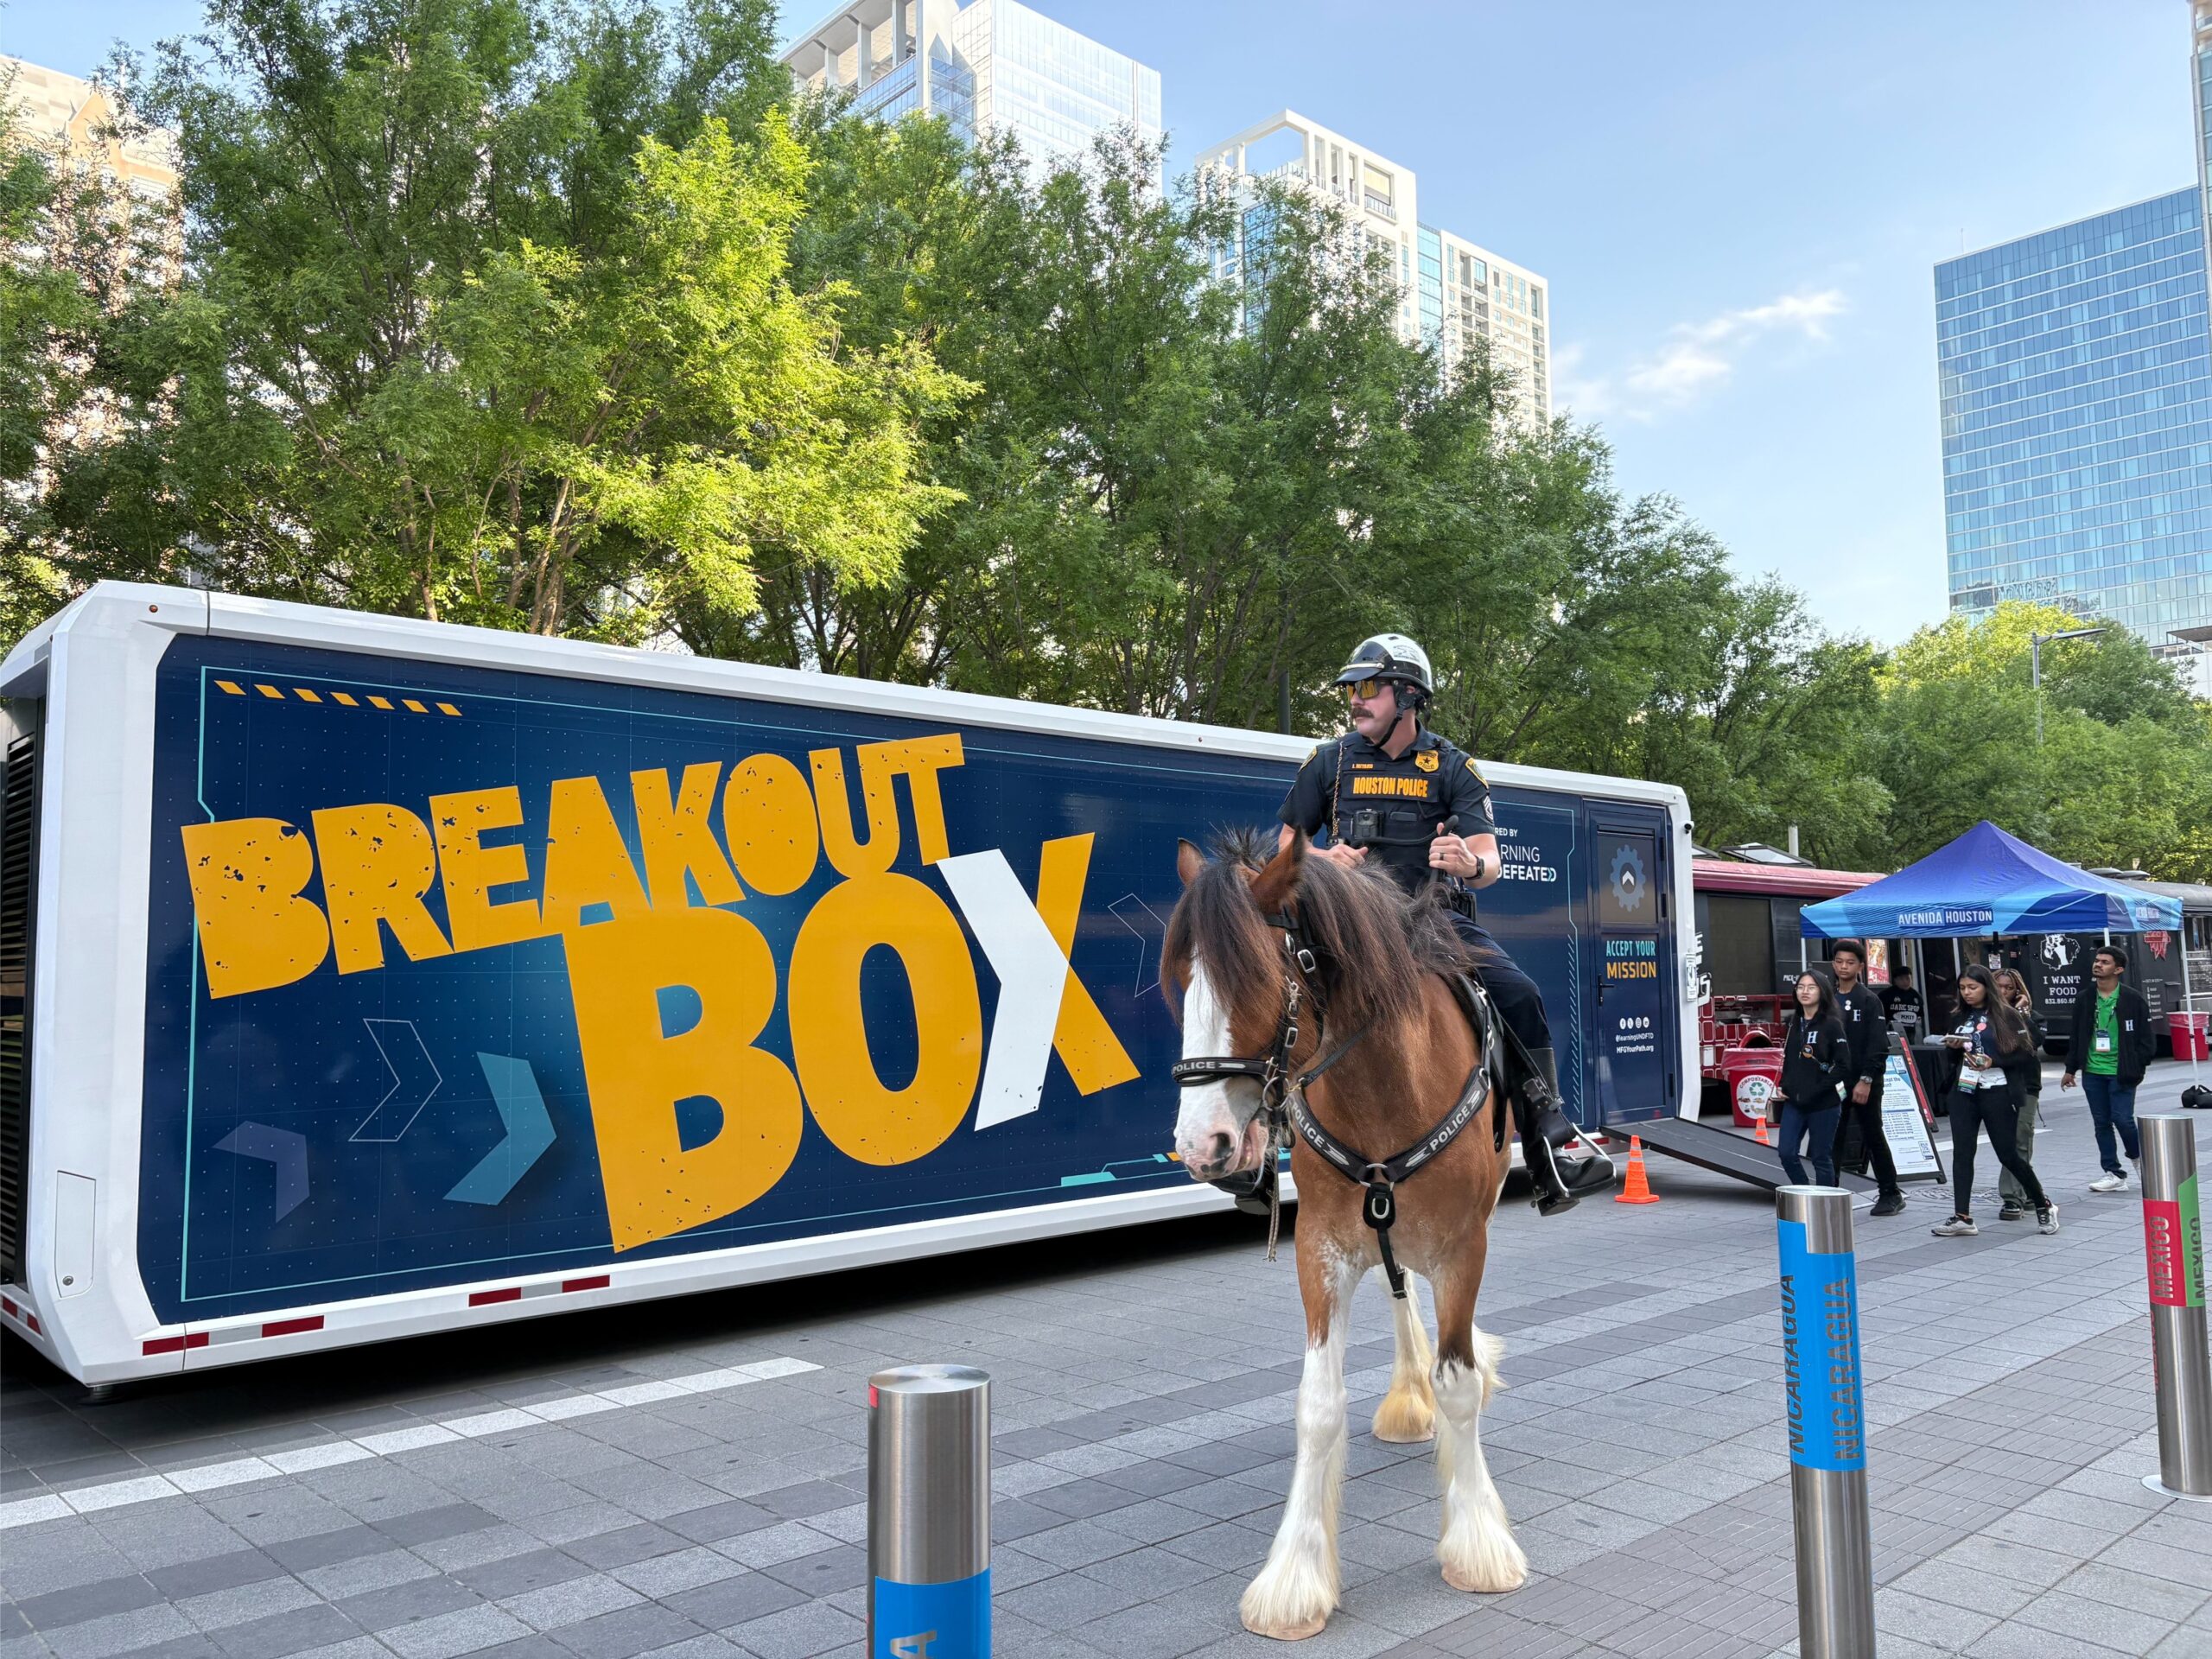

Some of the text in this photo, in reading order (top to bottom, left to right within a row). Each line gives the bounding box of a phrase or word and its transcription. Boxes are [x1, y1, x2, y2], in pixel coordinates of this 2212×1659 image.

[1353, 777, 1428, 798] HOUSTON POLICE
[1495, 827, 1518, 837] RED BY
[1500, 843, 1541, 862] RNING
[181, 733, 965, 999] BREAKOUT
[1898, 910, 1993, 925] AVENIDA HOUSTON
[1605, 940, 1656, 957] ACCEPT YOUR
[1606, 962, 1656, 979] MISSION
[2051, 976, 2081, 984] WANT
[2049, 987, 2077, 995] FOOD
[2125, 1020, 2134, 1032] H
[563, 832, 1141, 1253] BOX
[1806, 1031, 1818, 1044] H
[1172, 1061, 1216, 1076] POLICE
[1739, 1076, 1774, 1089] COMPOSTABLE
[1429, 1105, 1470, 1151] POLICE
[2149, 1216, 2173, 1299] MEXICO
[1781, 1274, 1805, 1455] NICARAGUA
[1824, 1276, 1861, 1460] NICARAGUA
